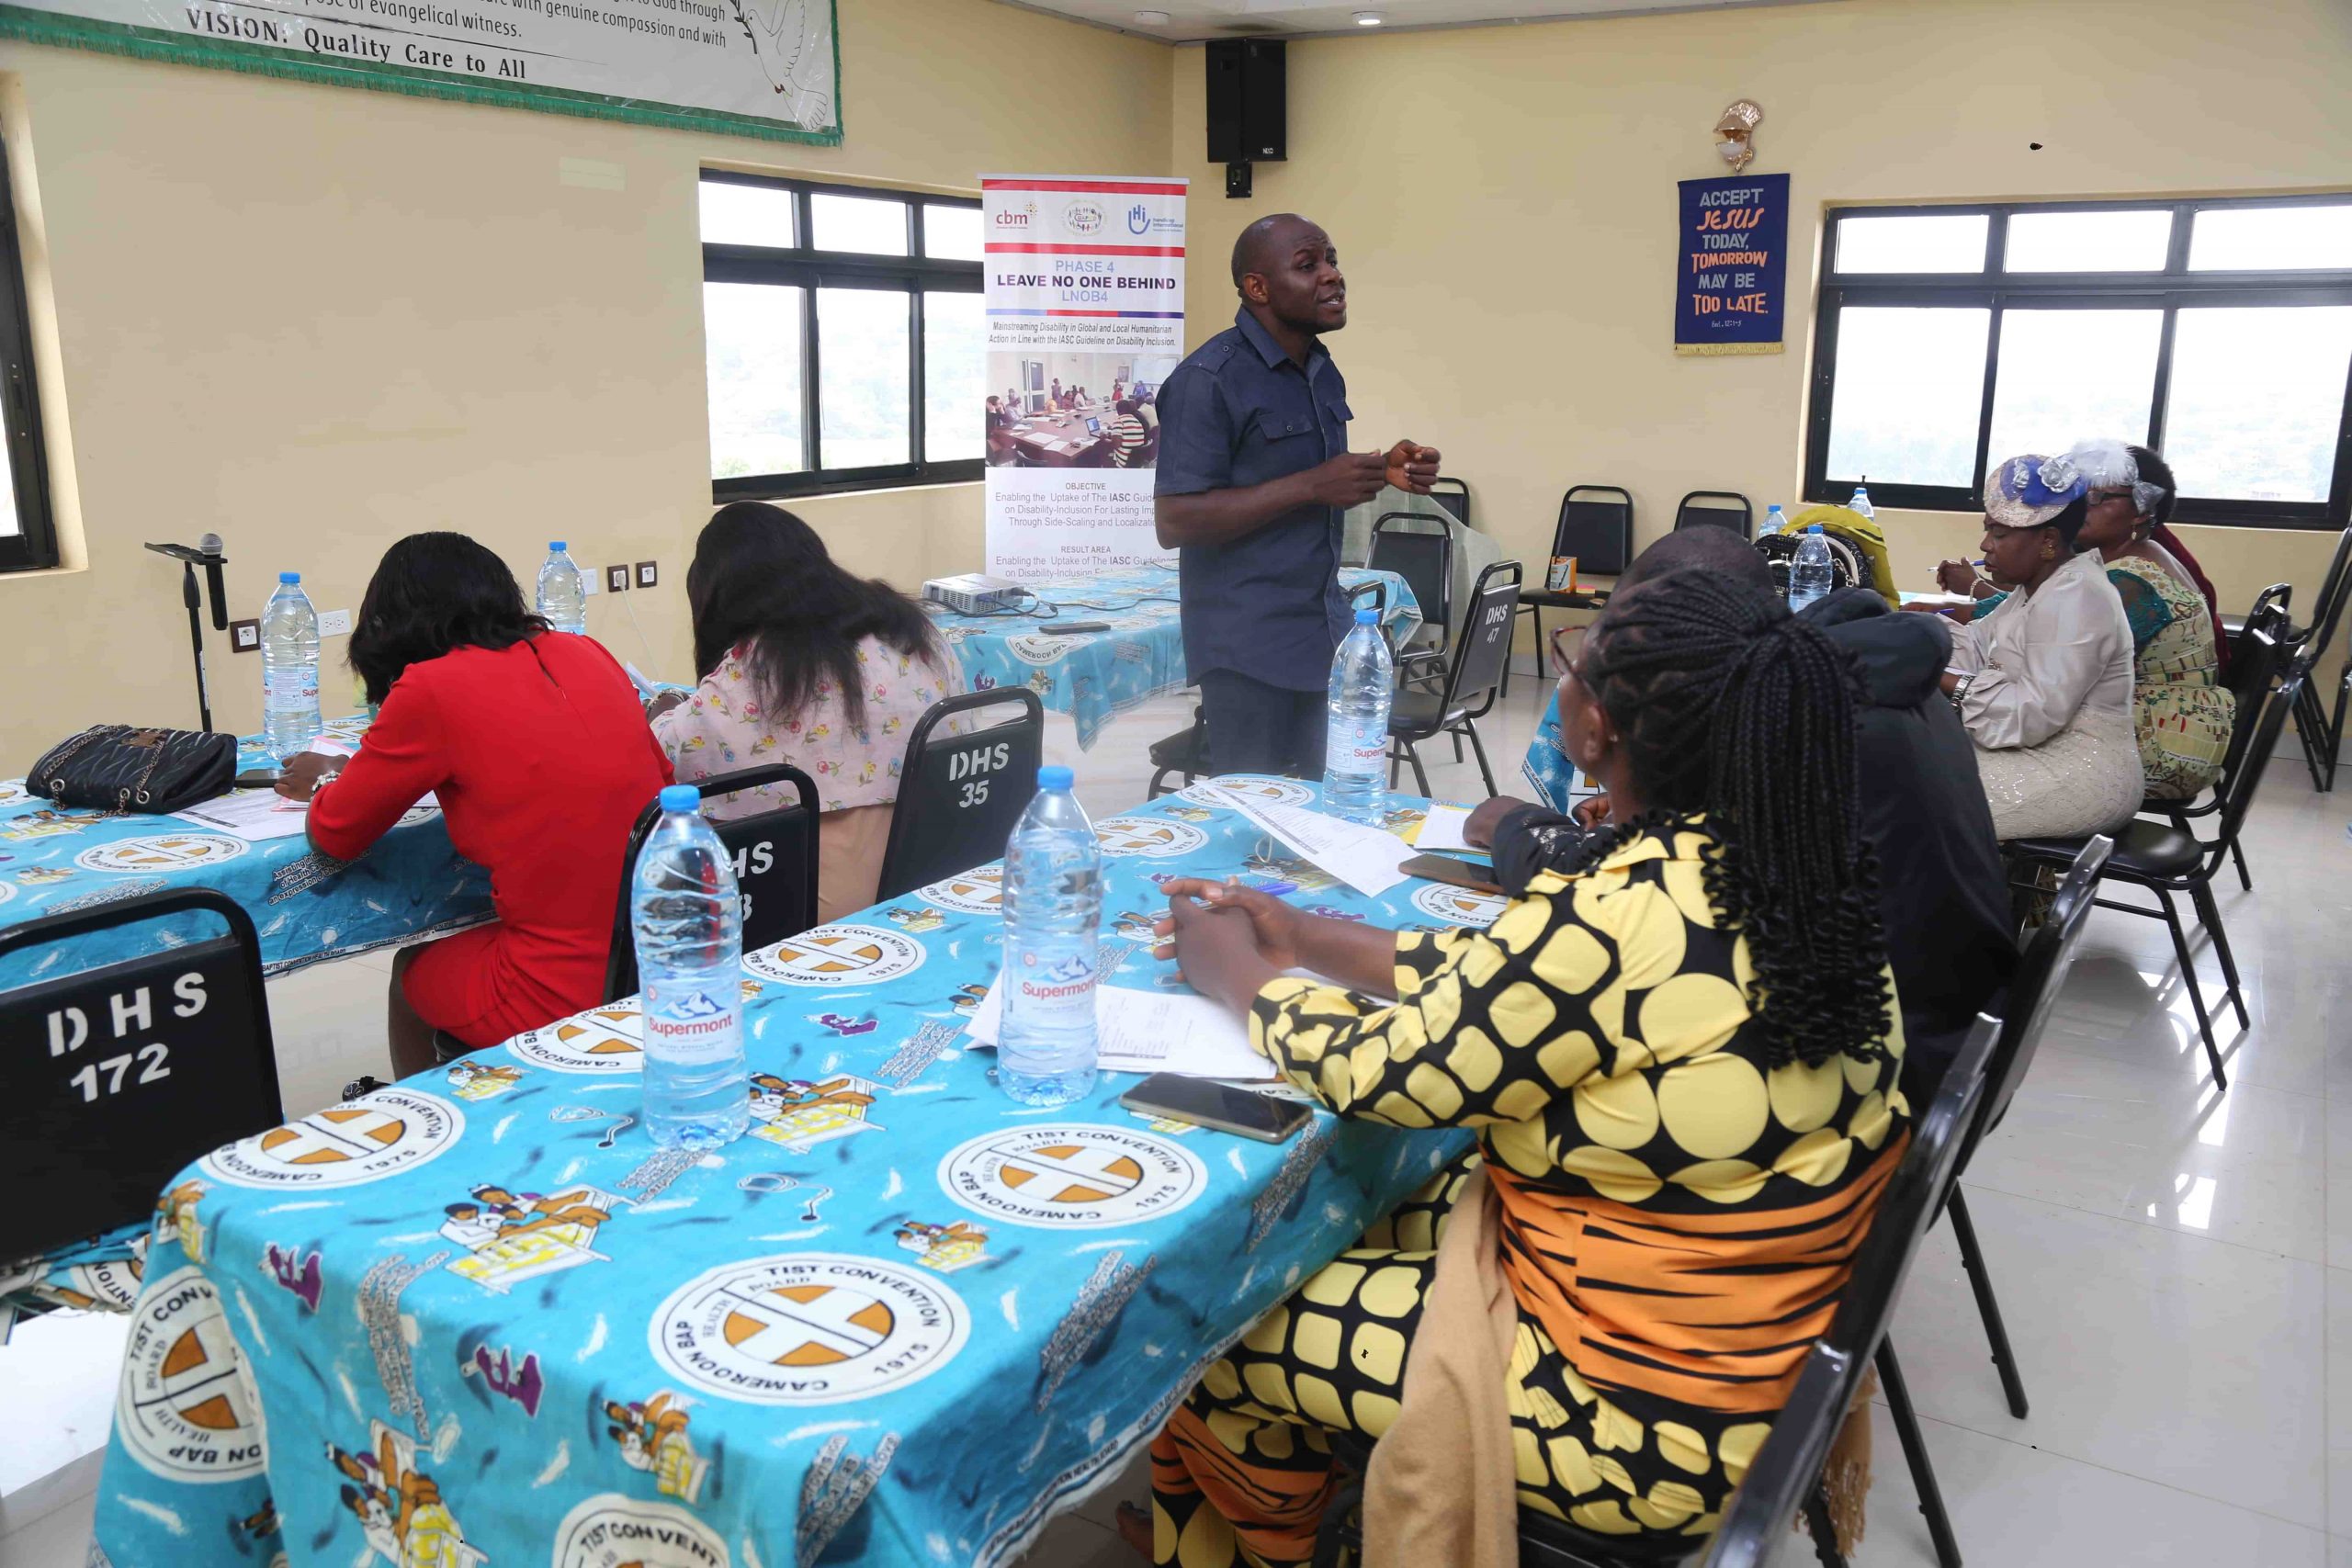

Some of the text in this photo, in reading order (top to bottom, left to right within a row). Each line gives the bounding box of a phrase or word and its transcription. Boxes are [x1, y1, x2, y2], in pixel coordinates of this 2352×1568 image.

[370, 0, 458, 27] evangelical
[462, 13, 522, 37] witness.
[681, 0, 725, 22] through
[547, 2, 599, 22] genuine
[603, 12, 675, 37] compassion
[678, 26, 700, 41] and
[703, 30, 726, 48] with
[186, 8, 526, 78] VISION: Quality Care to All
[1700, 188, 1764, 207] ACCEPT
[996, 209, 1028, 224] cbm
[1696, 208, 1764, 231] JESUS
[1702, 232, 1749, 250] TODAY,
[1056, 260, 1114, 273] PHASE 4
[1691, 251, 1768, 274] TOMORROW
[998, 275, 1176, 289] LEAVE NO ONE BEHIND
[1698, 273, 1755, 289] MAY BE
[1062, 290, 1108, 302] LNOB4
[1692, 292, 1769, 315] TOO LATE.
[993, 321, 1171, 333] Mainstreaming Disability in Global and Local Humanitarian
[989, 334, 1009, 344] Action
[1010, 334, 1016, 343] in
[1018, 333, 1031, 344] Line
[1033, 334, 1046, 344] with
[1047, 335, 1057, 344] the
[1058, 335, 1074, 344] IASC
[1076, 336, 1105, 344] Guideline
[1116, 336, 1145, 347] Disability
[1146, 337, 1175, 346] Inclusion.
[995, 492, 1031, 504] Enabling
[1033, 492, 1046, 502] the
[1050, 493, 1080, 504] Uptake
[1081, 493, 1091, 502] of
[1092, 493, 1107, 502] The
[1109, 493, 1131, 502] IASC
[1066, 482, 1106, 491] OBJECTIVE
[1017, 505, 1092, 516] Disability-Inclusion
[1094, 505, 1107, 514] For
[1111, 505, 1138, 516] Lasting
[1010, 517, 1042, 528] Through
[1045, 517, 1095, 528] Side-Scaling
[1098, 518, 1113, 526] and
[996, 557, 1131, 568] Enabling the Uptake of The IASC
[1486, 604, 1508, 625] DHS
[949, 742, 1010, 781] DHS
[959, 780, 989, 808] 35
[273, 859, 305, 880] Assisting
[731, 840, 774, 878] HS
[280, 879, 288, 888] of
[288, 868, 311, 885] Health
[268, 895, 278, 906] an
[278, 876, 318, 900] expression
[842, 929, 910, 957] CONVENTION
[263, 963, 284, 971] BAPTIST
[868, 963, 901, 977] 1975
[649, 1014, 732, 1038] Supermont
[529, 1044, 620, 1067] CAMEROON
[70, 1043, 171, 1102] 172
[375, 1095, 439, 1139] CONVENTION
[363, 1150, 417, 1171] 1975
[1023, 1131, 1182, 1174] TIST CONVENTION
[221, 1154, 322, 1181] CAMEROON
[977, 1192, 1102, 1220] CAMEROON
[1135, 1185, 1177, 1209] 1975
[764, 1264, 942, 1327] TIST CONVENTION
[129, 1323, 154, 1363] TIST
[675, 1321, 829, 1391] CAMEROON BAP
[874, 1343, 930, 1375] 1975
[168, 1446, 220, 1464] BAP
[580, 1523, 608, 1552] TIST
